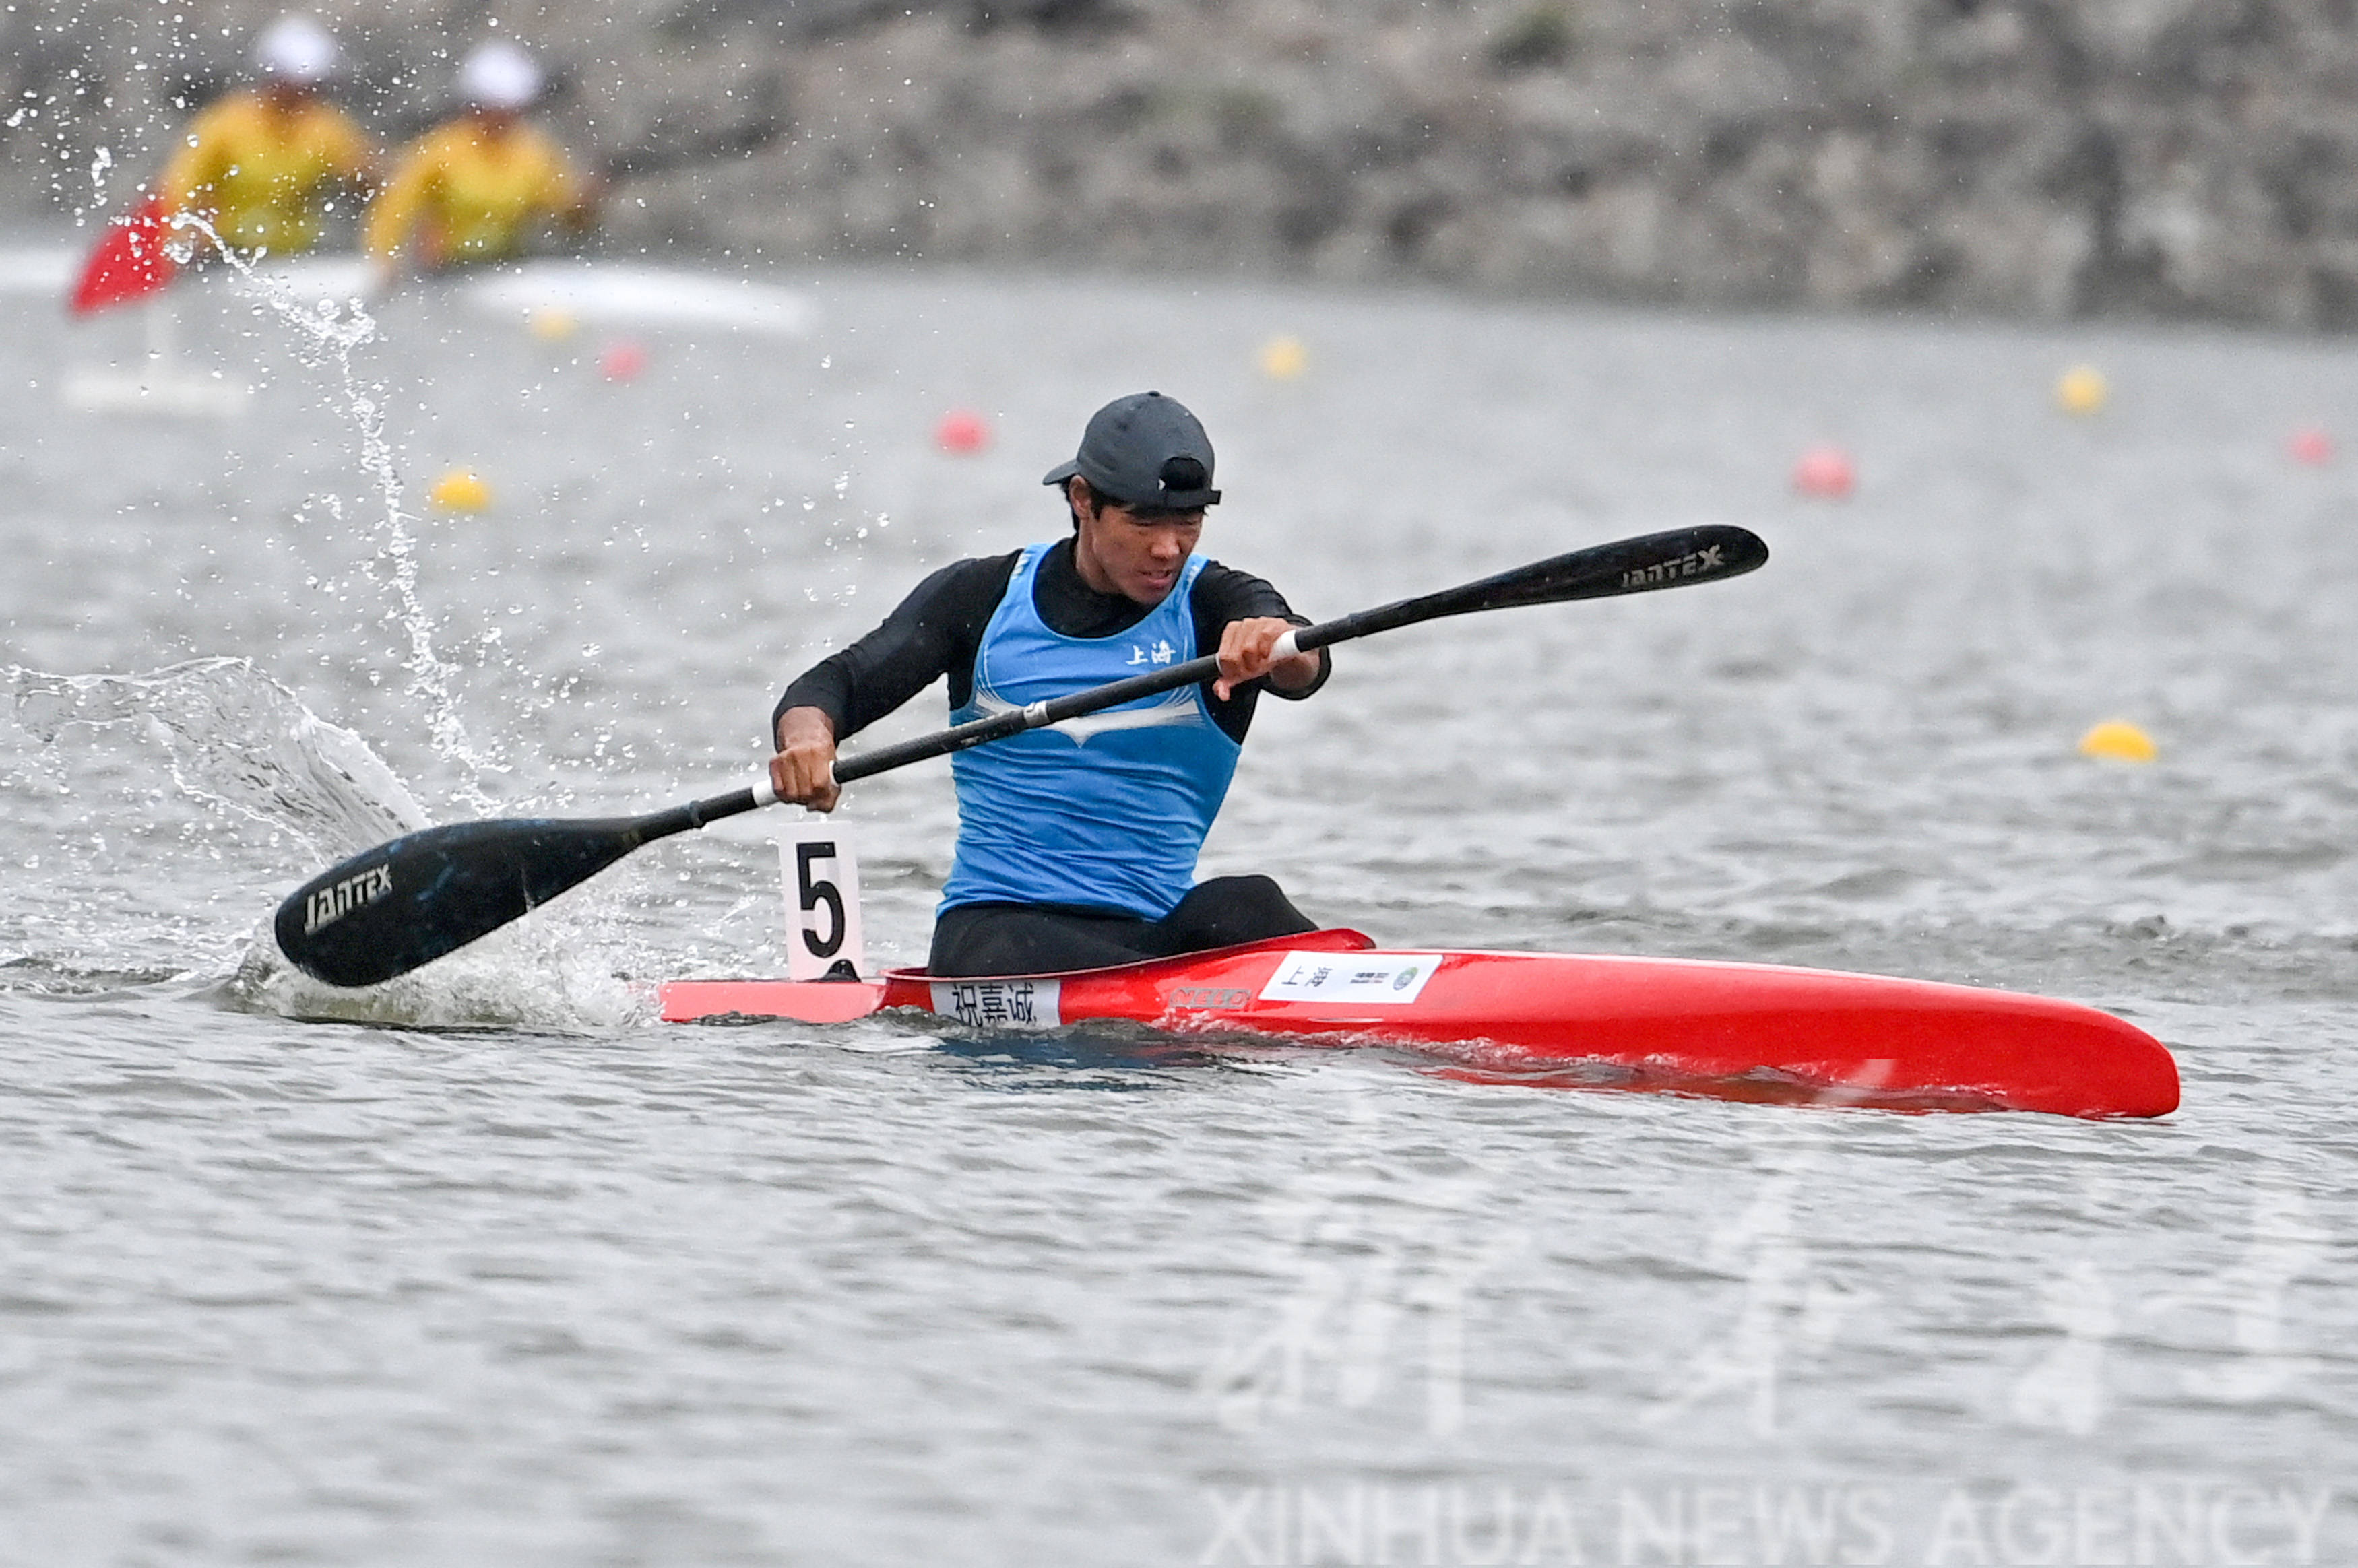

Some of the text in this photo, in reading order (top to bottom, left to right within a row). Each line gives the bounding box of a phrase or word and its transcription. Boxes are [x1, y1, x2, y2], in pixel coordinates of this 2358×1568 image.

[1126, 639, 1176, 665] 上海
[796, 841, 846, 958] 5
[952, 982, 1037, 1027] 祝嘉诚
